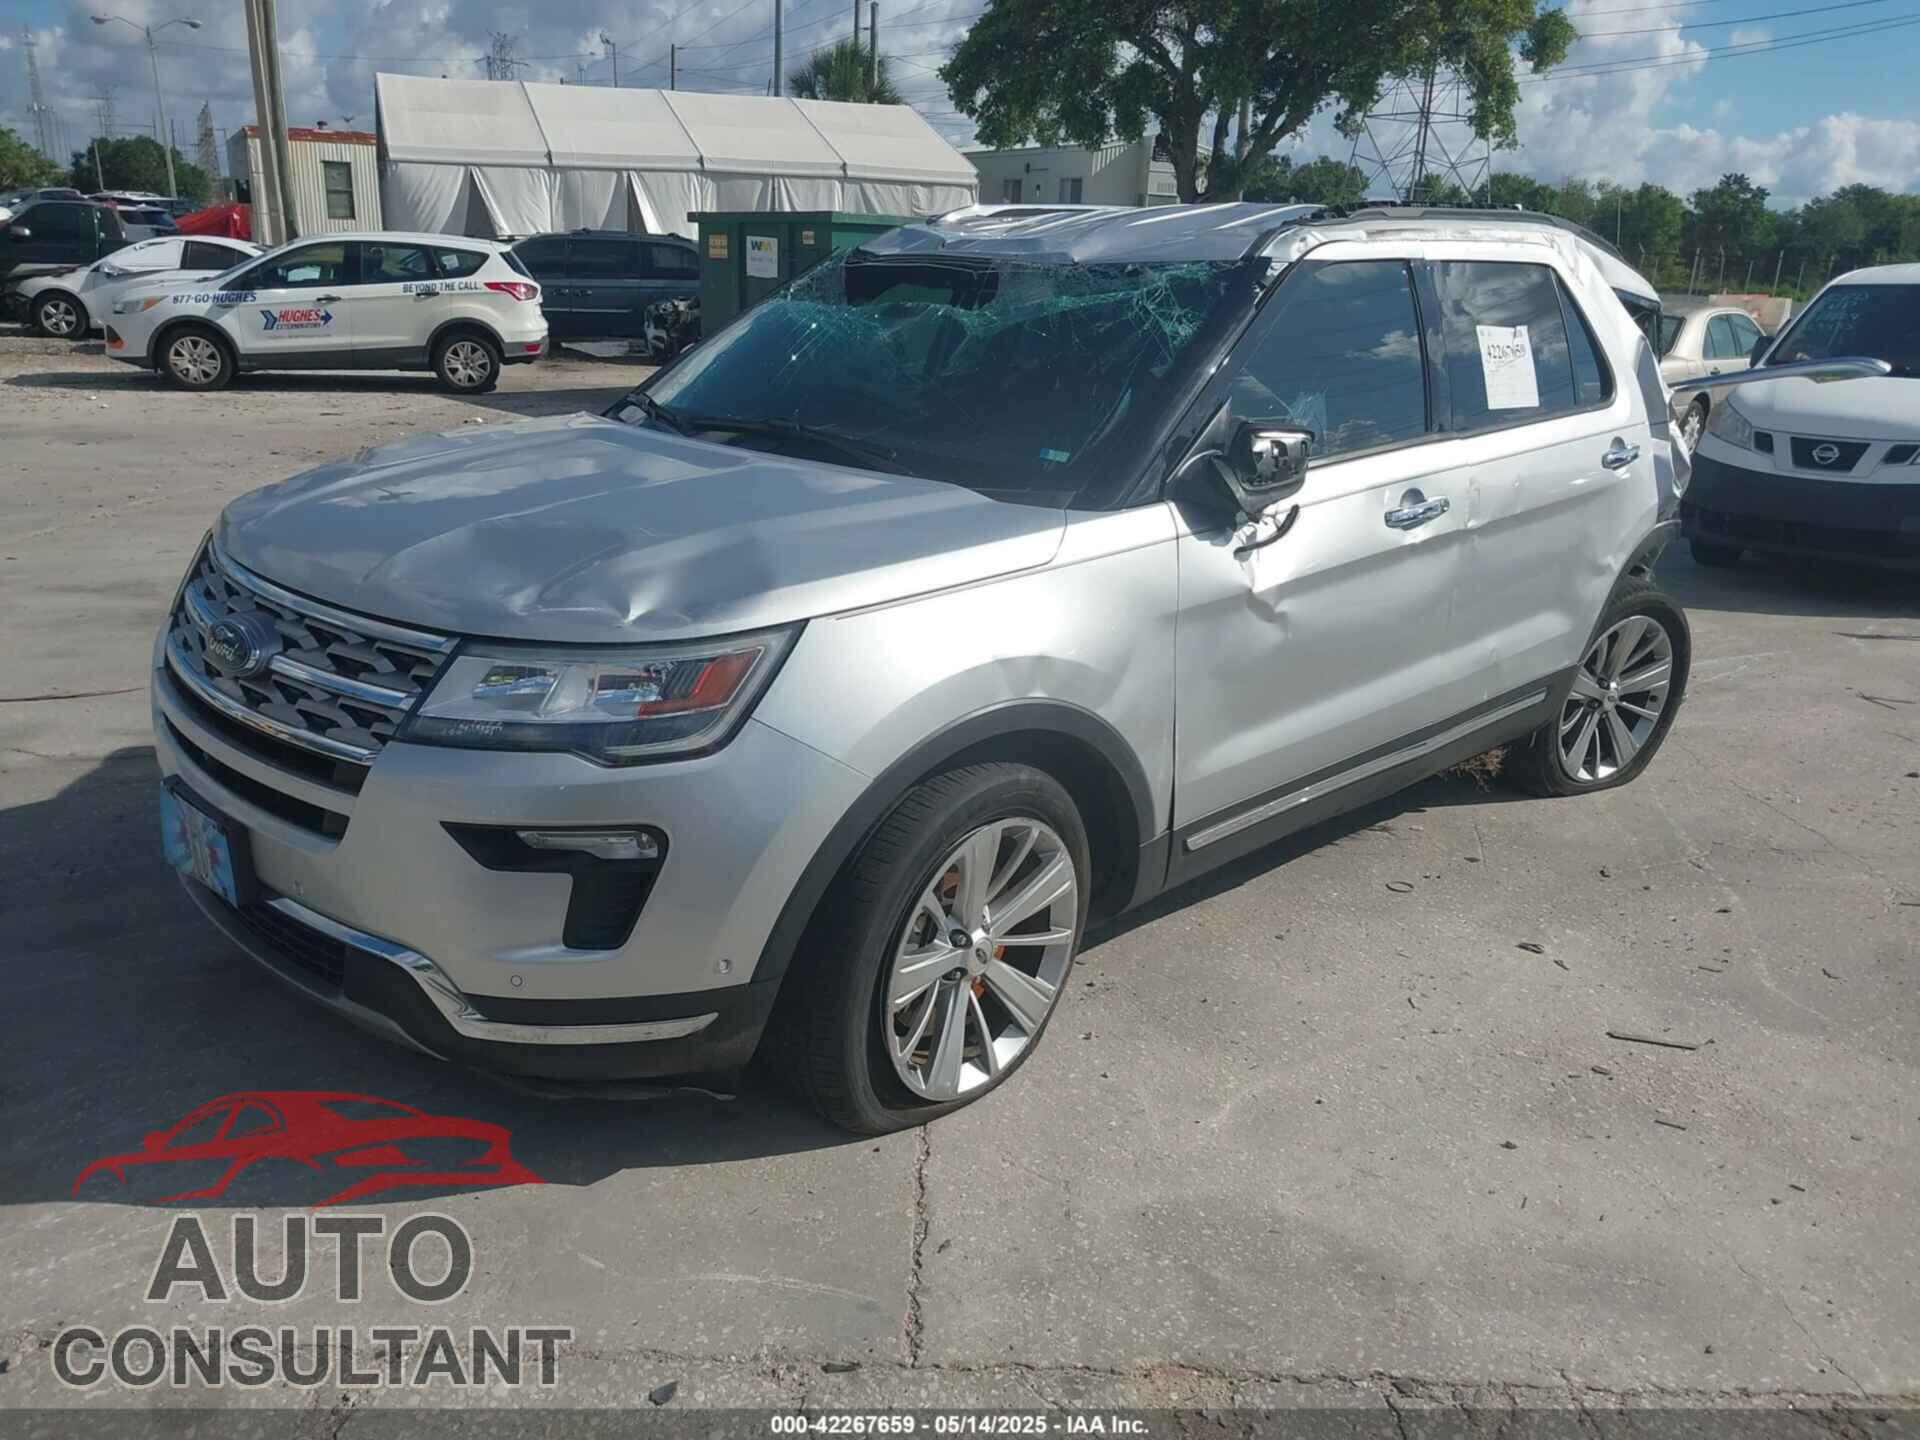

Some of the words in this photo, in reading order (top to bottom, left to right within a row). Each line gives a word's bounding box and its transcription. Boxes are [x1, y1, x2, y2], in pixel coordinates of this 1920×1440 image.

[403, 283, 436, 293] BEYOND
[440, 282, 455, 291] THE
[279, 309, 320, 321] HUGHES
